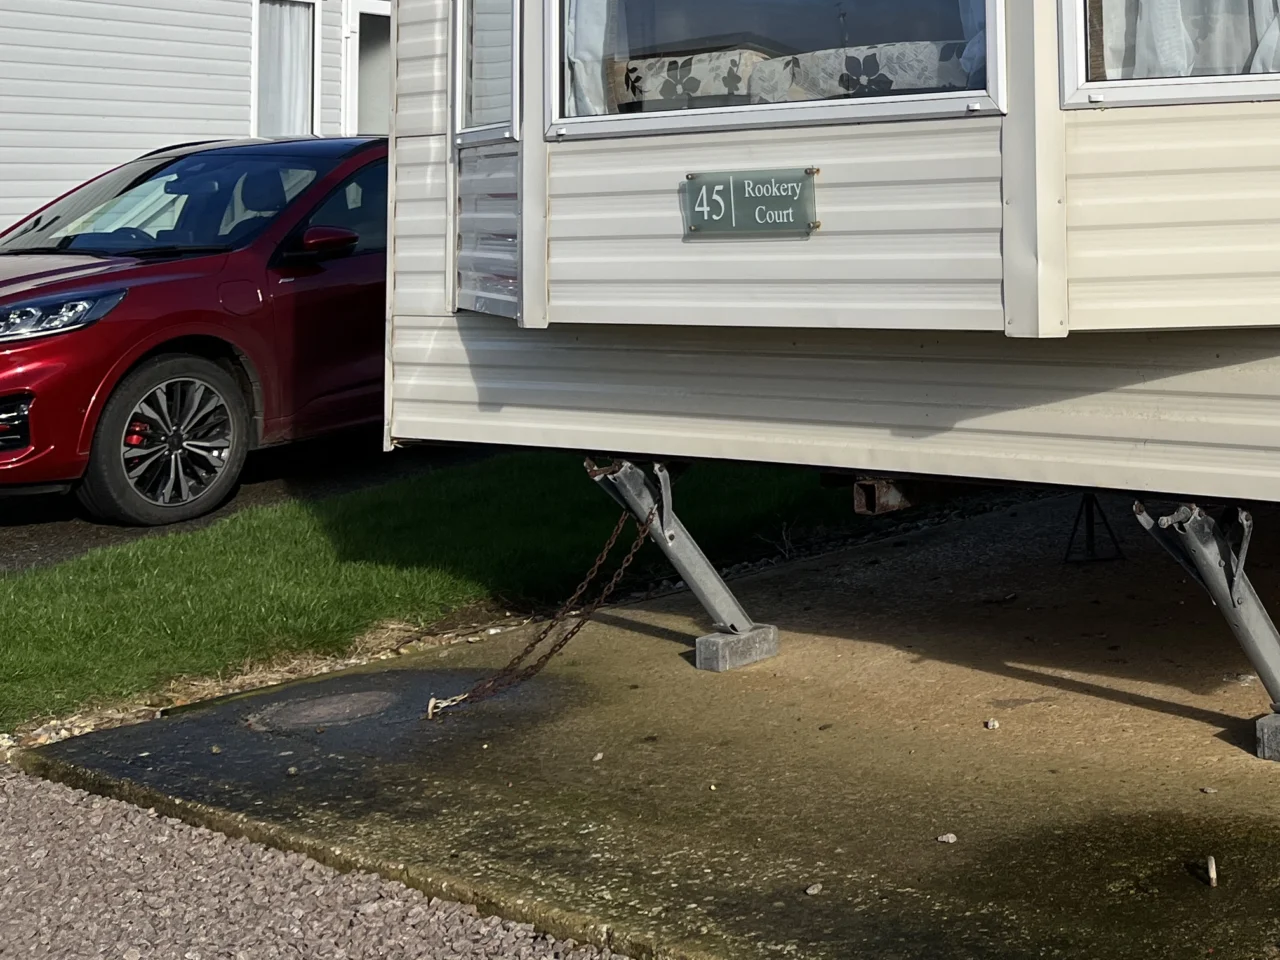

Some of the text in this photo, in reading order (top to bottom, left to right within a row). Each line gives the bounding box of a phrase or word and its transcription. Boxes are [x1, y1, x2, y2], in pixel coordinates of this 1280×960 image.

[743, 178, 802, 200] Rookery
[694, 185, 725, 220] 45
[755, 205, 794, 224] Court
